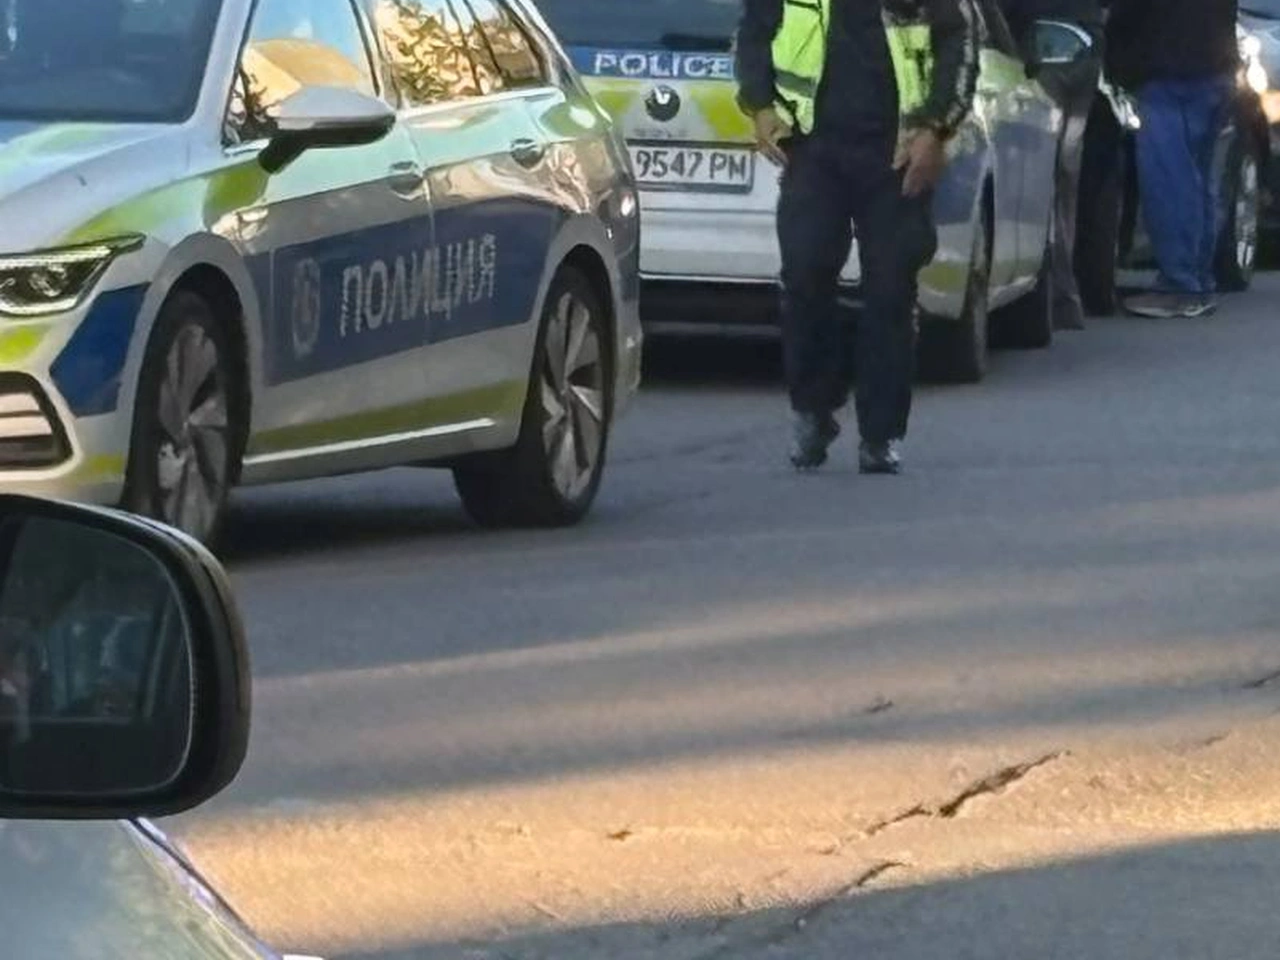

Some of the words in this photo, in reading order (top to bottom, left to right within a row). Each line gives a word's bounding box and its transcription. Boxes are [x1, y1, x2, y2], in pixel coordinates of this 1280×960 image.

[594, 52, 734, 77] POLICE
[636, 150, 702, 178] 9547
[340, 233, 496, 338] ПОЛИЦИЯ
